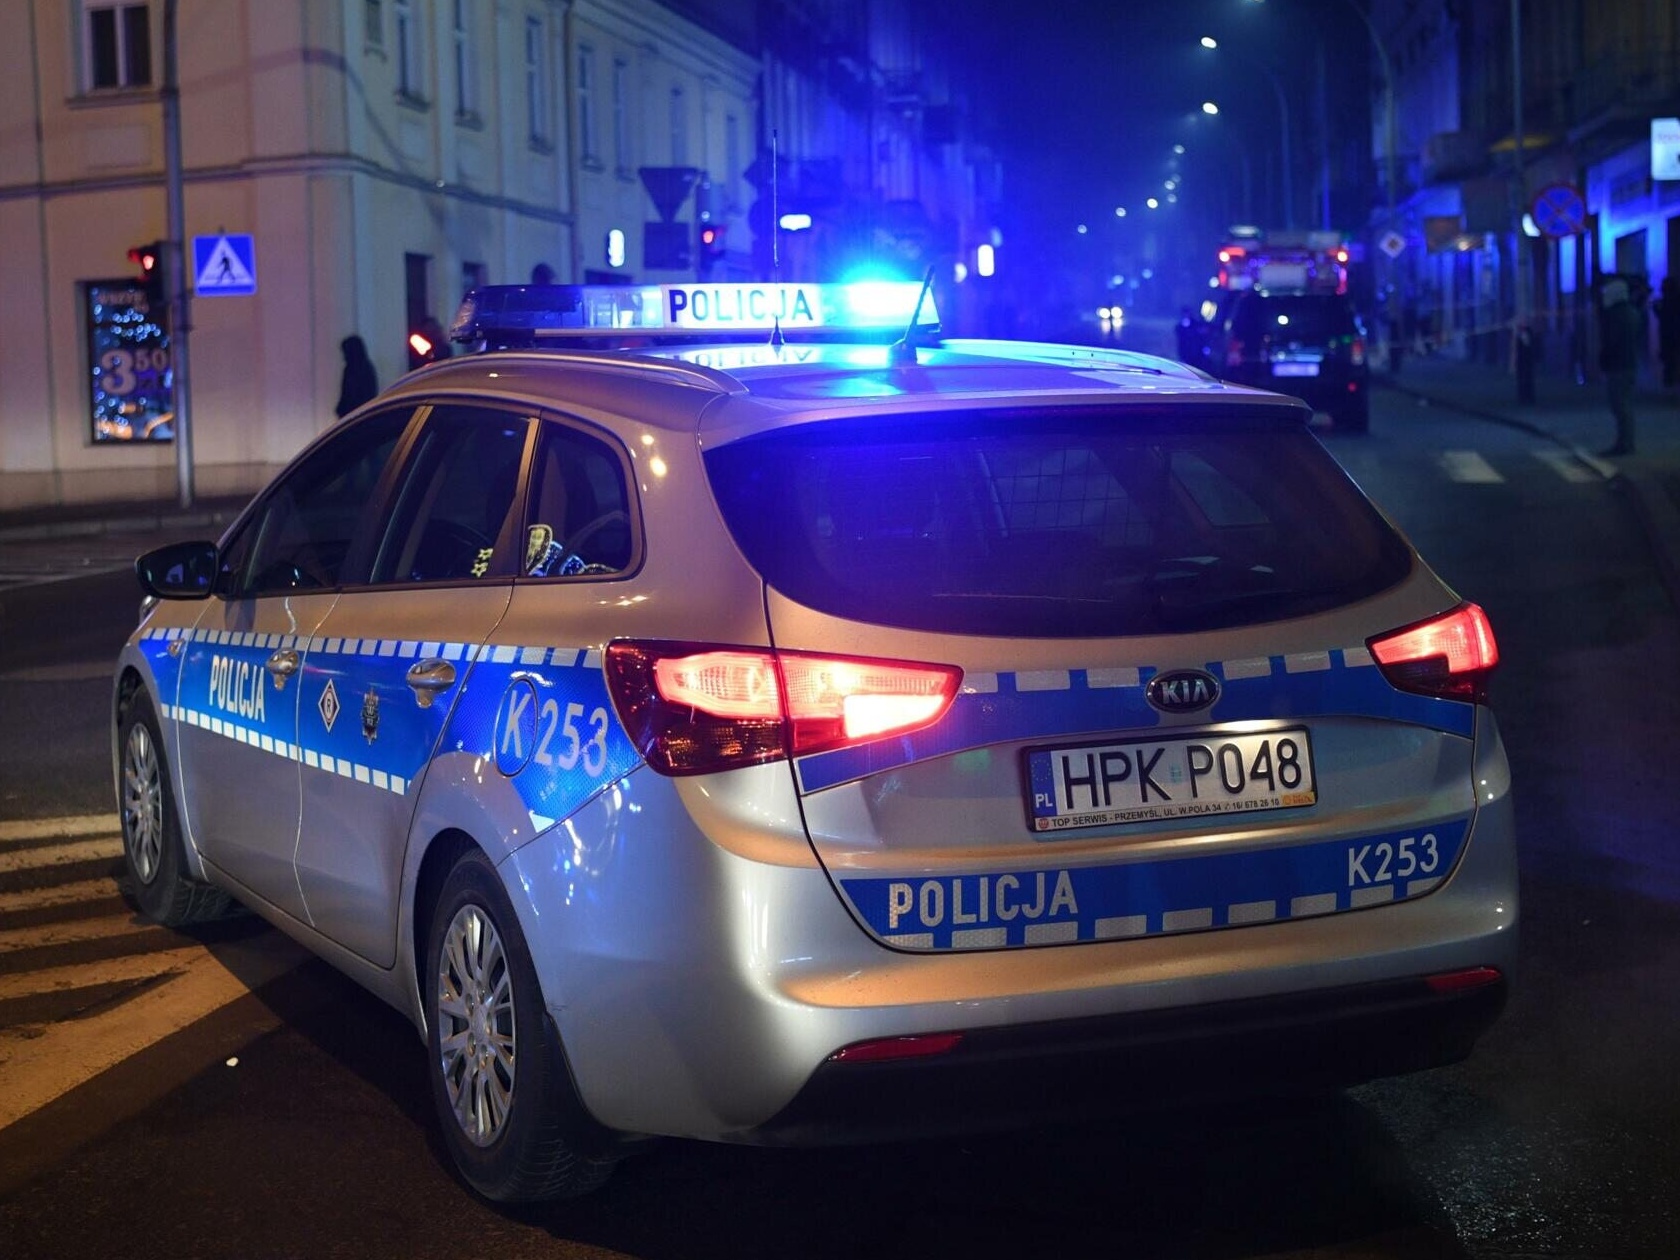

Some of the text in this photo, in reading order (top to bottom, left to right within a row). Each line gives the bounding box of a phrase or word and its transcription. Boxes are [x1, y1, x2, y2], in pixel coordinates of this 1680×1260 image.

[668, 288, 814, 323] POLICJA
[208, 654, 266, 723] POLICJA
[1160, 679, 1210, 704] KIA
[1034, 793, 1053, 808] PL
[1061, 747, 1172, 810] HPK
[1052, 818, 1070, 828] TOP
[1073, 814, 1108, 826] SERWIS
[1348, 833, 1439, 887] K253
[889, 870, 1079, 929] POLICJA
